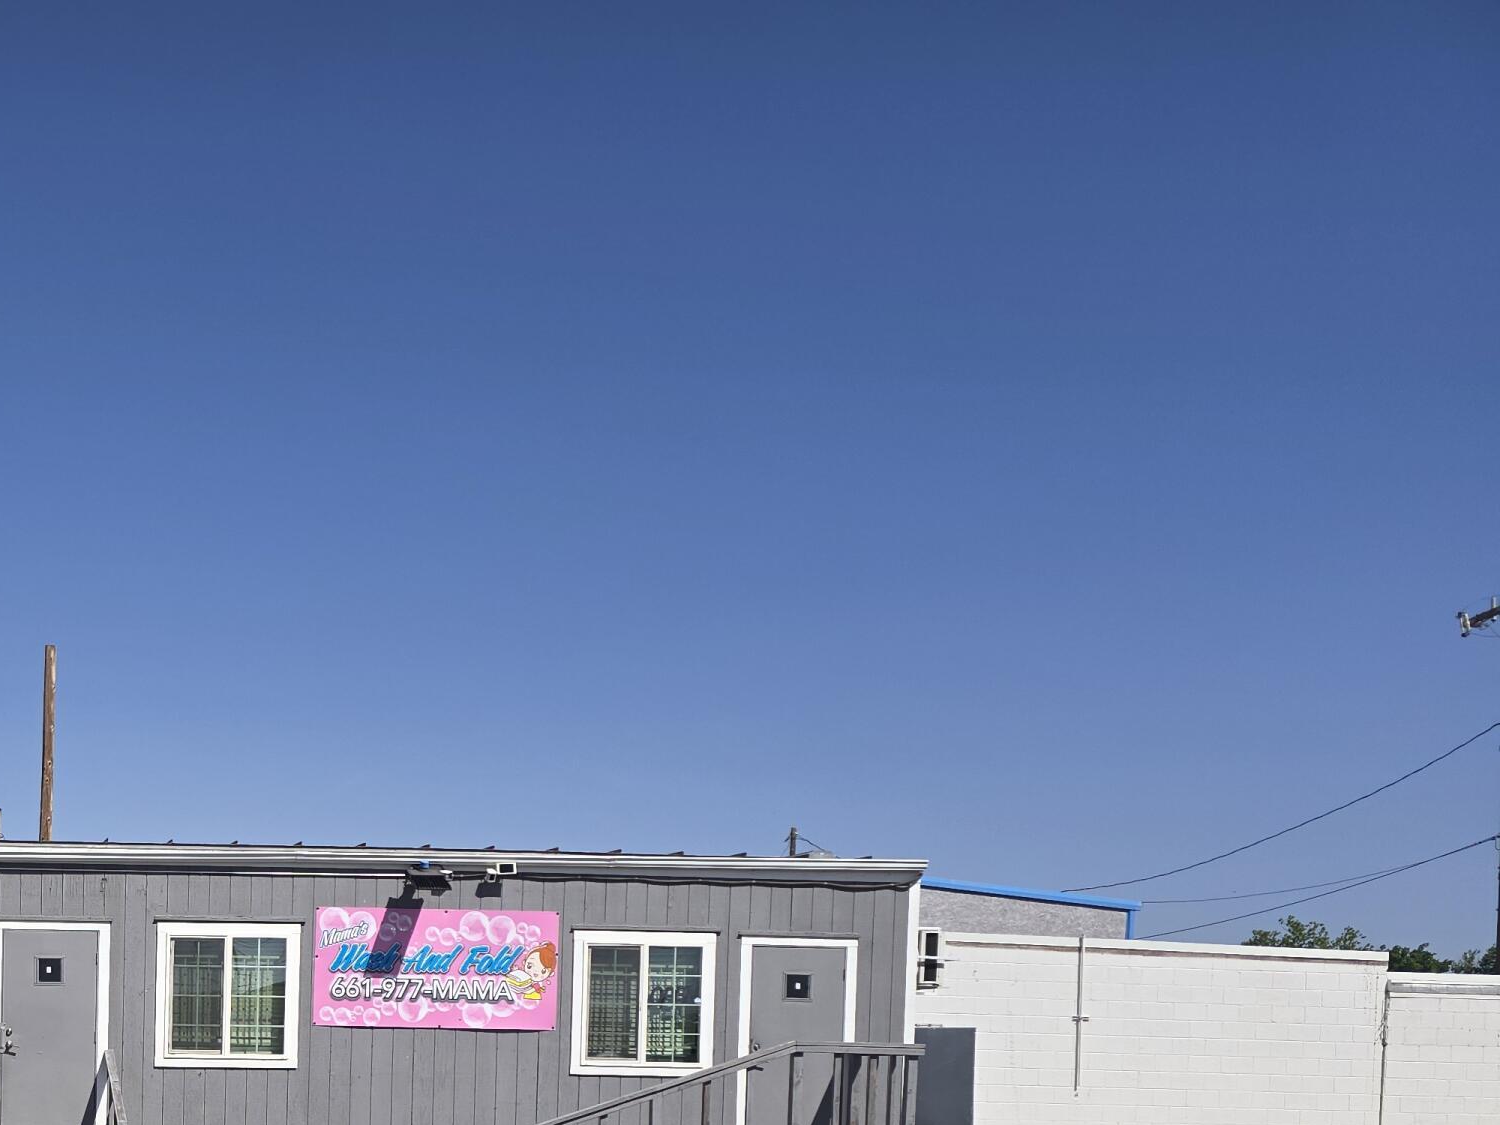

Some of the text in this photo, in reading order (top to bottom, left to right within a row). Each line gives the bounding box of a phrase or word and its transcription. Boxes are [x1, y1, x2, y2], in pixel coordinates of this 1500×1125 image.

[319, 920, 369, 948] Mama's
[328, 943, 526, 976] Wash And Fold
[331, 976, 514, 1002] 661-977-MAMA
